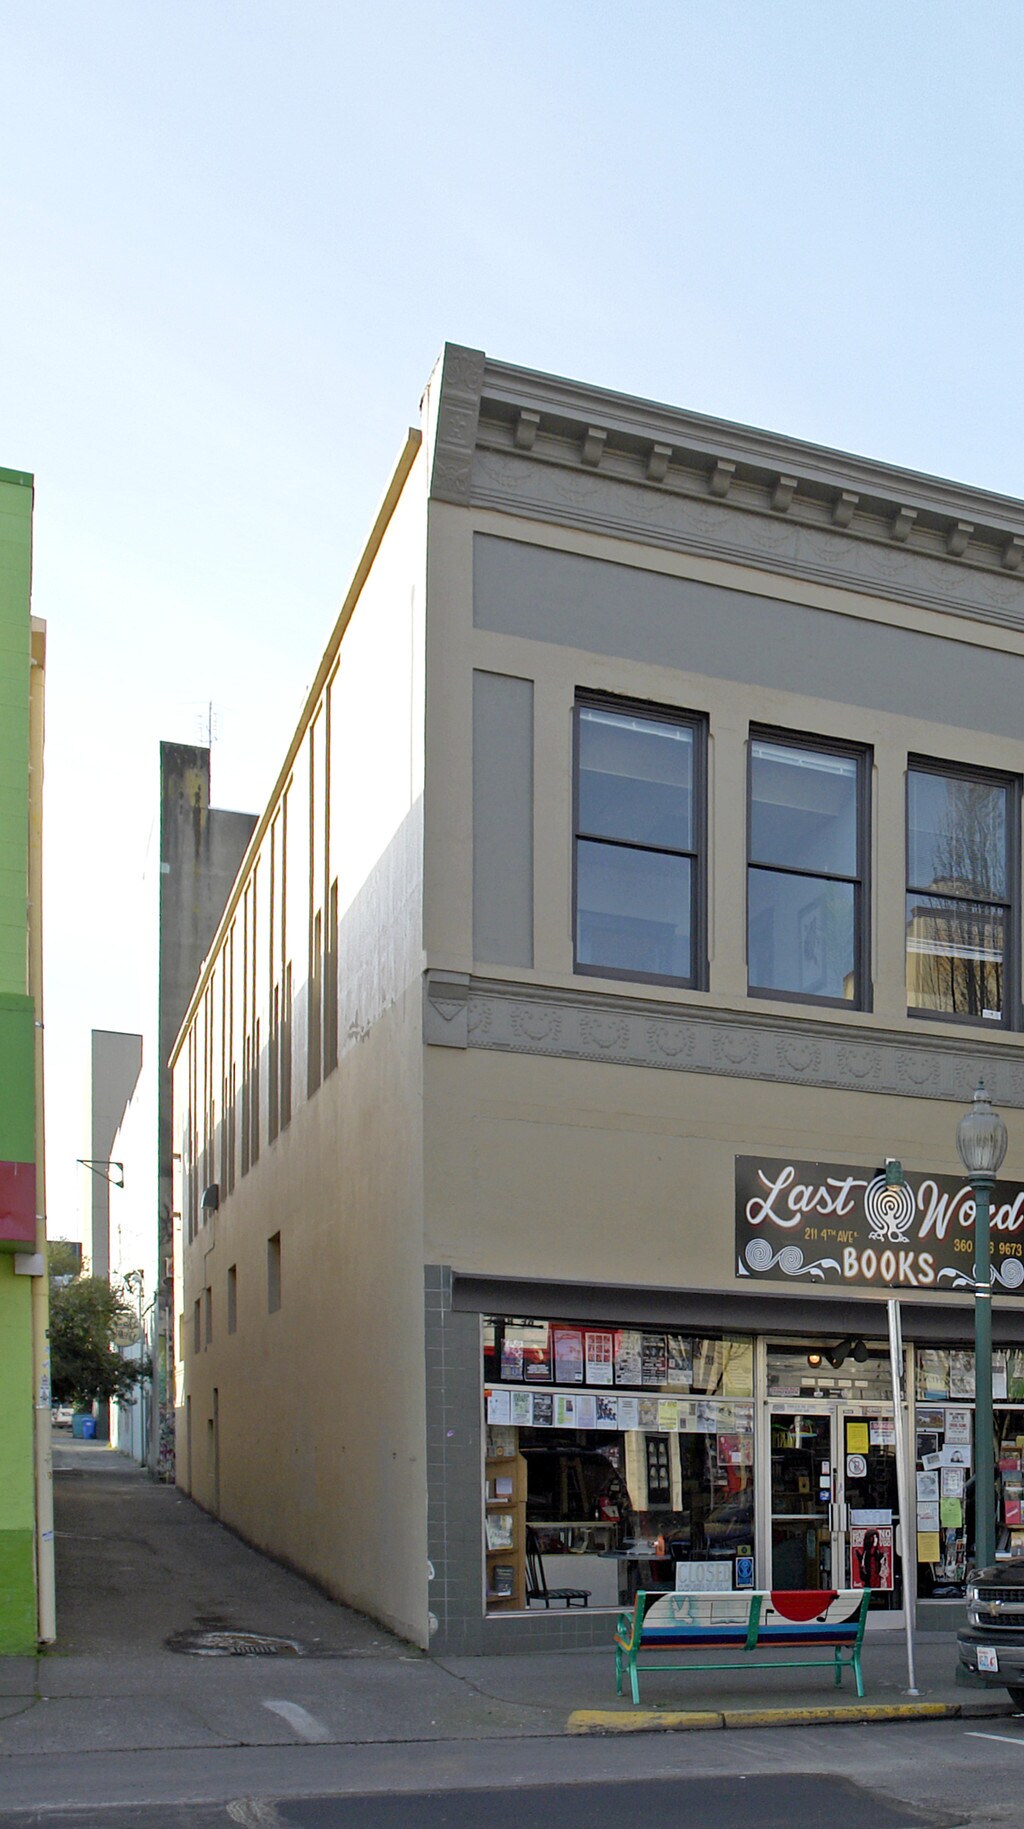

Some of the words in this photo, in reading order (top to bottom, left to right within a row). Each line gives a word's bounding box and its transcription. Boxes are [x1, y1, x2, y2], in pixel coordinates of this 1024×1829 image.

[745, 1165, 868, 1227] Last
[804, 1227, 818, 1240] 211
[953, 1238, 973, 1253] 360
[998, 1242, 1023, 1257] 9673
[842, 1246, 935, 1286] BOOKS
[678, 1563, 731, 1583] CLOSED
